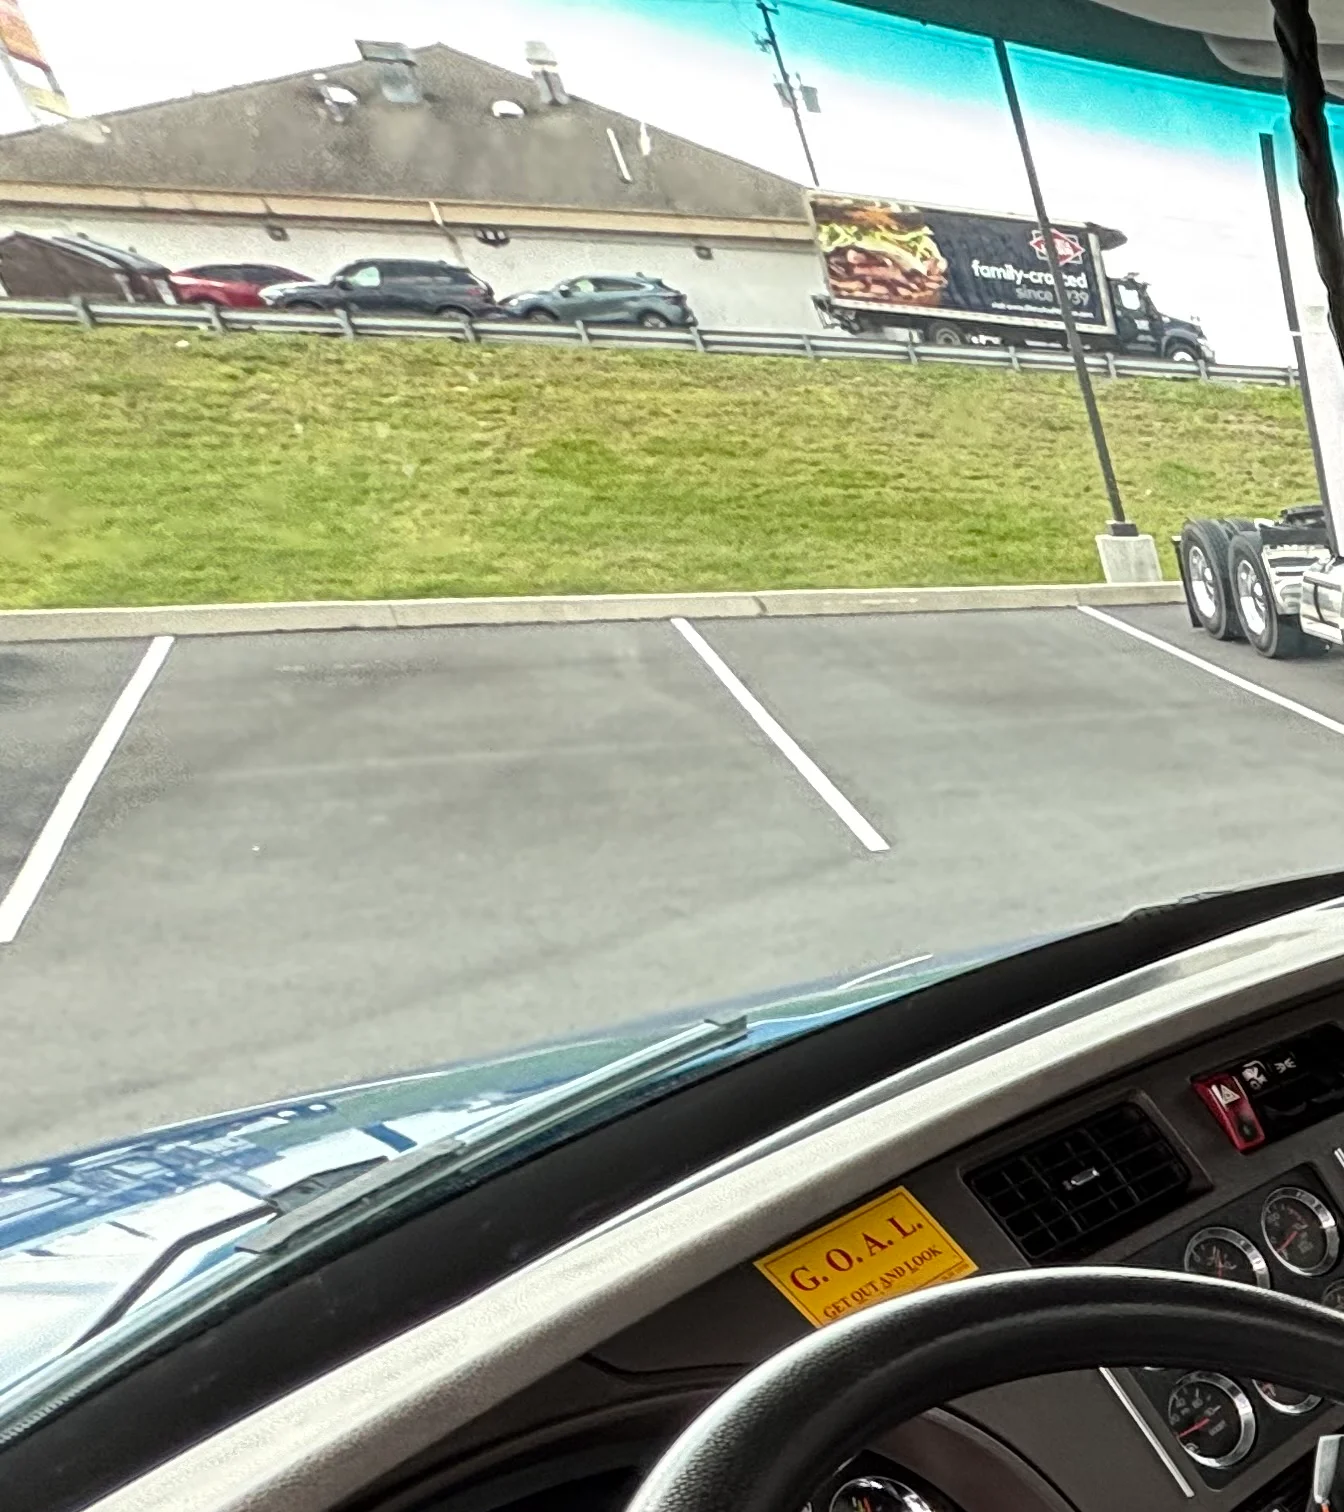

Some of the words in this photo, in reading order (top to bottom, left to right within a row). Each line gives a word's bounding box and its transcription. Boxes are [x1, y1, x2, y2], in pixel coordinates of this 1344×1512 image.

[1015, 284, 1053, 302] since
[823, 1296, 851, 1319] GET
[851, 1278, 881, 1304] OUT
[881, 1264, 906, 1289] AND
[905, 1245, 943, 1274] LOOK
